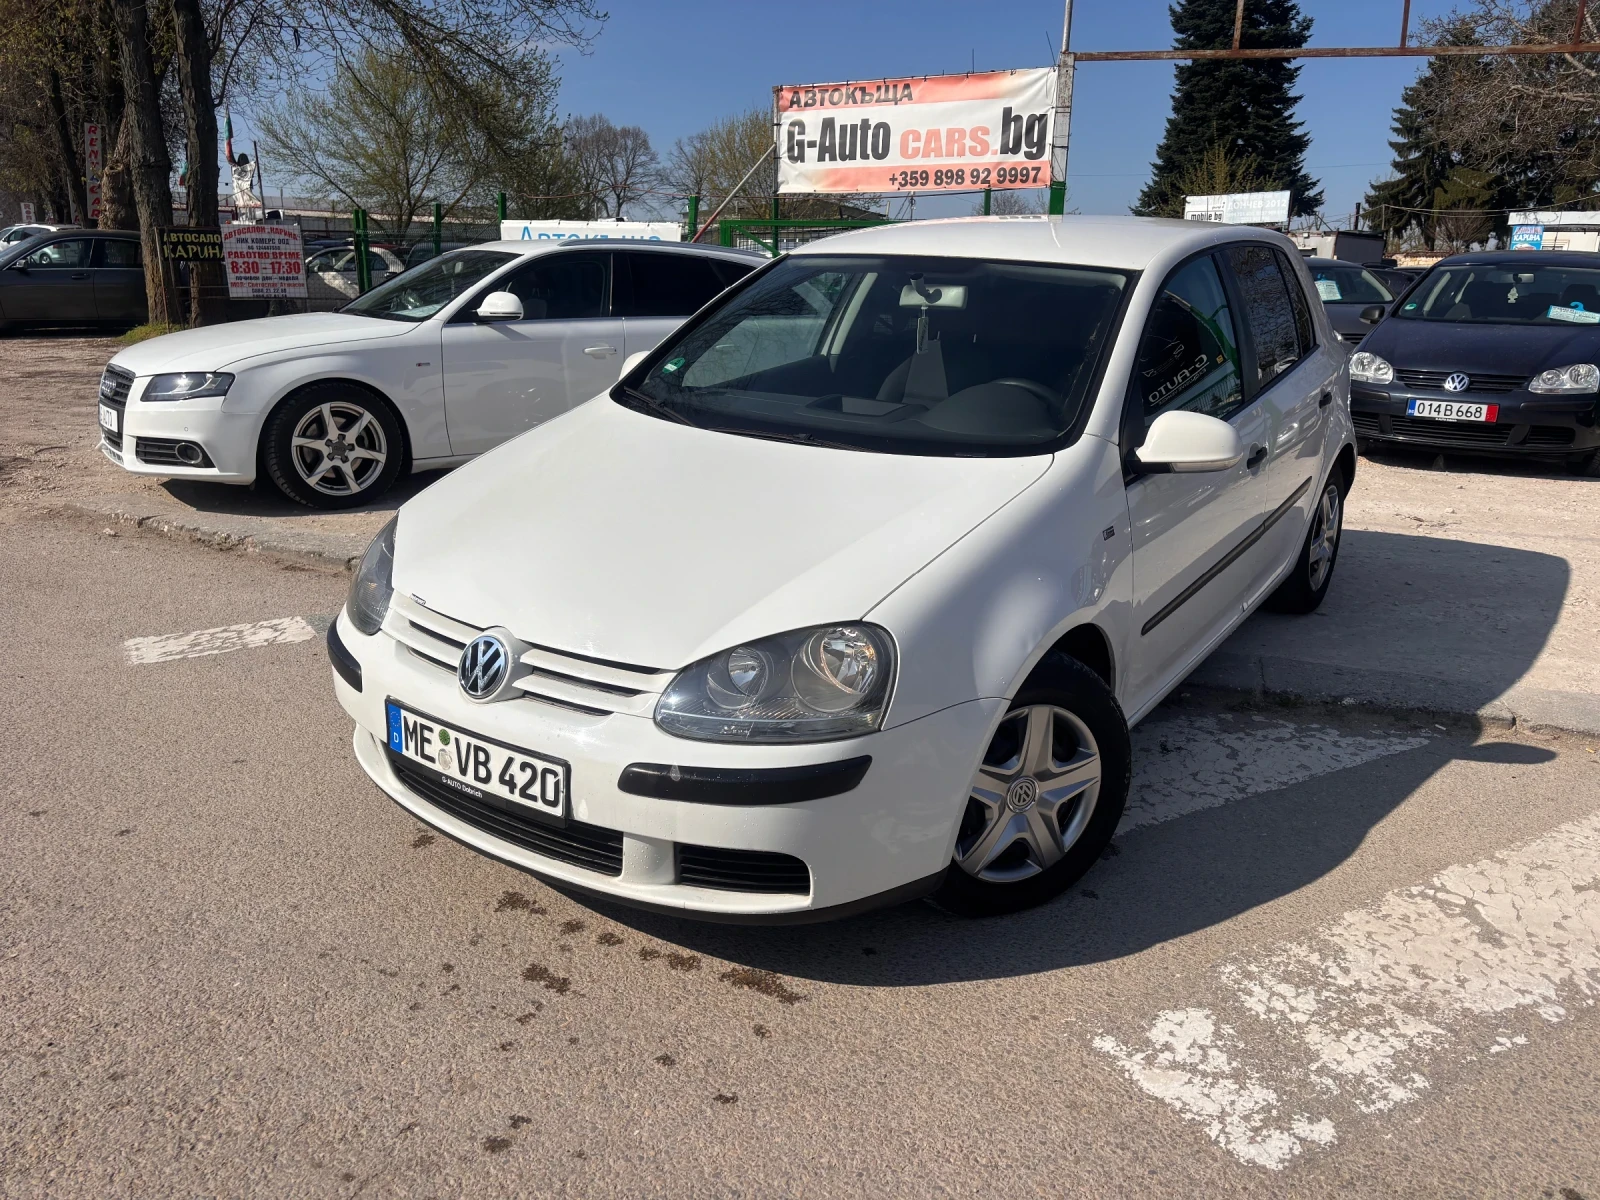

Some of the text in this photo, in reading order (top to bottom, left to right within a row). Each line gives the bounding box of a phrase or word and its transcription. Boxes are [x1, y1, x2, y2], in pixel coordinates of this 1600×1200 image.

[788, 83, 914, 108] АВТОКЪЩА
[786, 116, 892, 165] G-Auto
[888, 166, 1043, 188] +359 898 92 9997
[1265, 199, 1287, 208] 2012
[163, 232, 222, 244] АВТОСАЛО
[224, 226, 266, 241] АВТОСАЛОН
[250, 237, 276, 245] КОМЕРС
[227, 250, 301, 260] РАБОТНО ВРЕМЕ
[230, 261, 260, 275] 8:30
[270, 261, 302, 275] 17:30
[393, 731, 400, 744] D
[403, 715, 561, 809] ME VB 420
[461, 784, 483, 799] Dobrich
